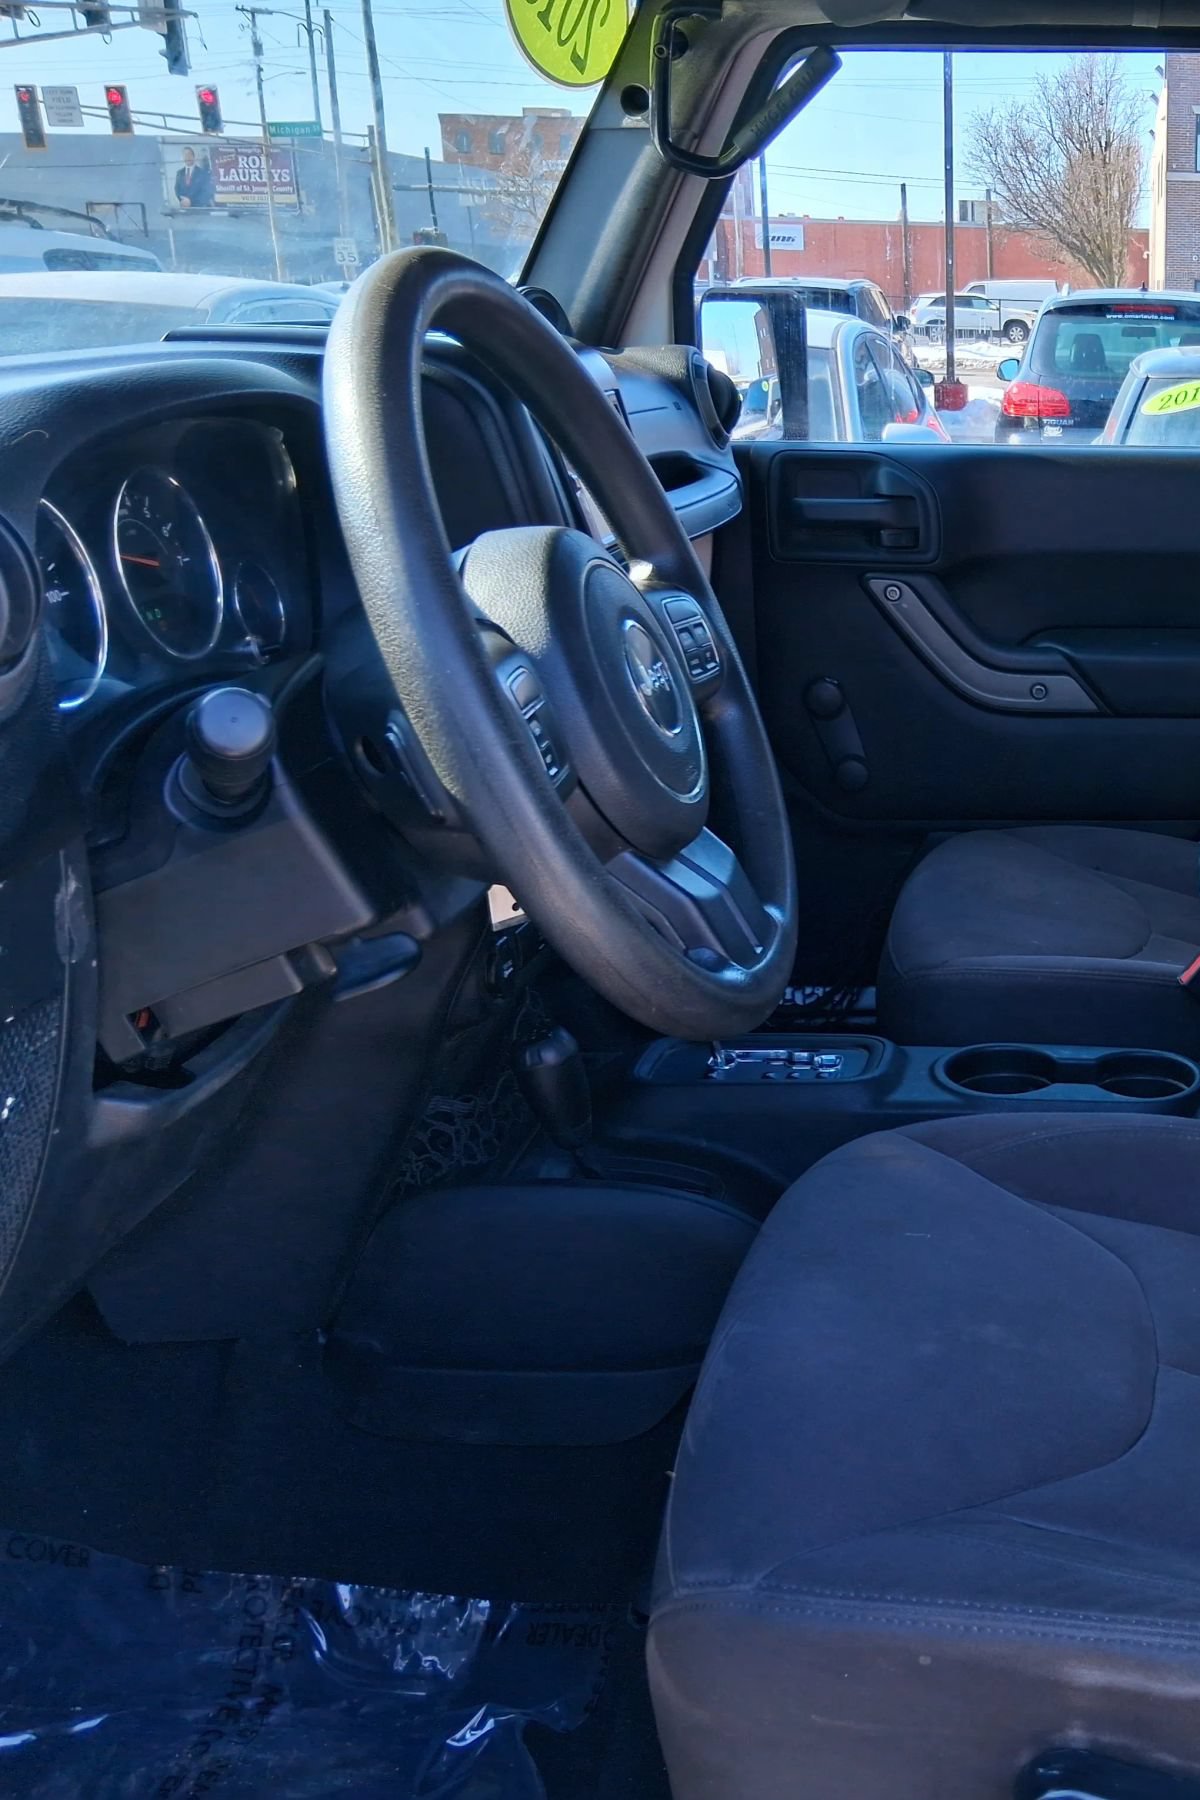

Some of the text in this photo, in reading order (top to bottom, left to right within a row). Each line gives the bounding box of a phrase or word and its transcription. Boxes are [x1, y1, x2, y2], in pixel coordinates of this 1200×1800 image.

[269, 126, 311, 136] Michigan
[337, 251, 357, 263] 35
[46, 589, 63, 604] 100
[7, 1536, 89, 1570] COVER
[527, 1622, 600, 1647] DEALER
